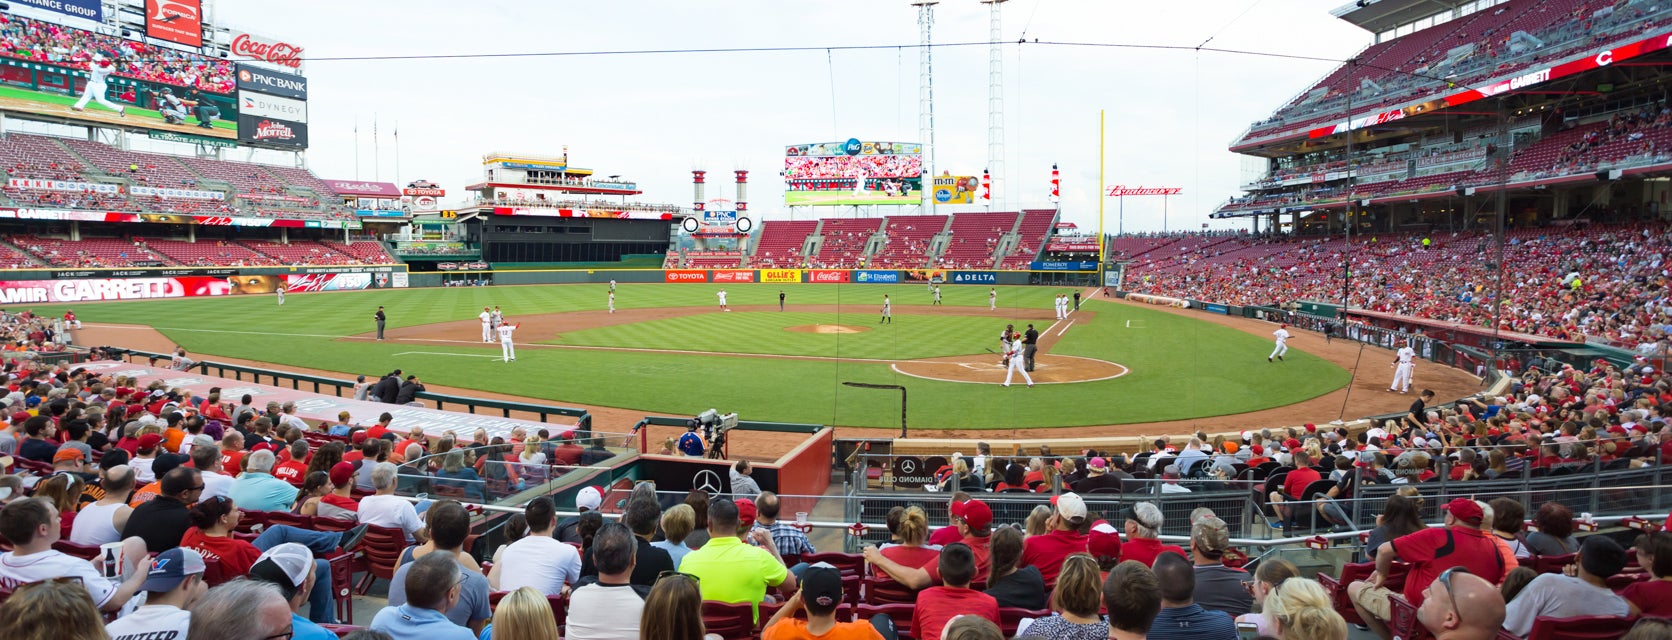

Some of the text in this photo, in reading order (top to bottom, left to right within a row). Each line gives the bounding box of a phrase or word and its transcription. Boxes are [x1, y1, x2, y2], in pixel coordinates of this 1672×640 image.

[64, 4, 96, 17] GROUP
[231, 33, 304, 68] Coca-Cola
[253, 73, 305, 92] PNC BANK
[1510, 68, 1551, 90] GARRETT
[259, 101, 301, 115] DYNEGY
[252, 127, 296, 139] Morrell
[150, 134, 189, 142] ULTIMATE
[202, 140, 236, 148] SHUTTLE
[1106, 185, 1182, 196] Budweiser
[816, 272, 841, 280] Coca-Cola
[874, 273, 897, 281] Elizabeth
[54, 278, 169, 302] GARRETT
[276, 467, 298, 478] PHILLIPS
